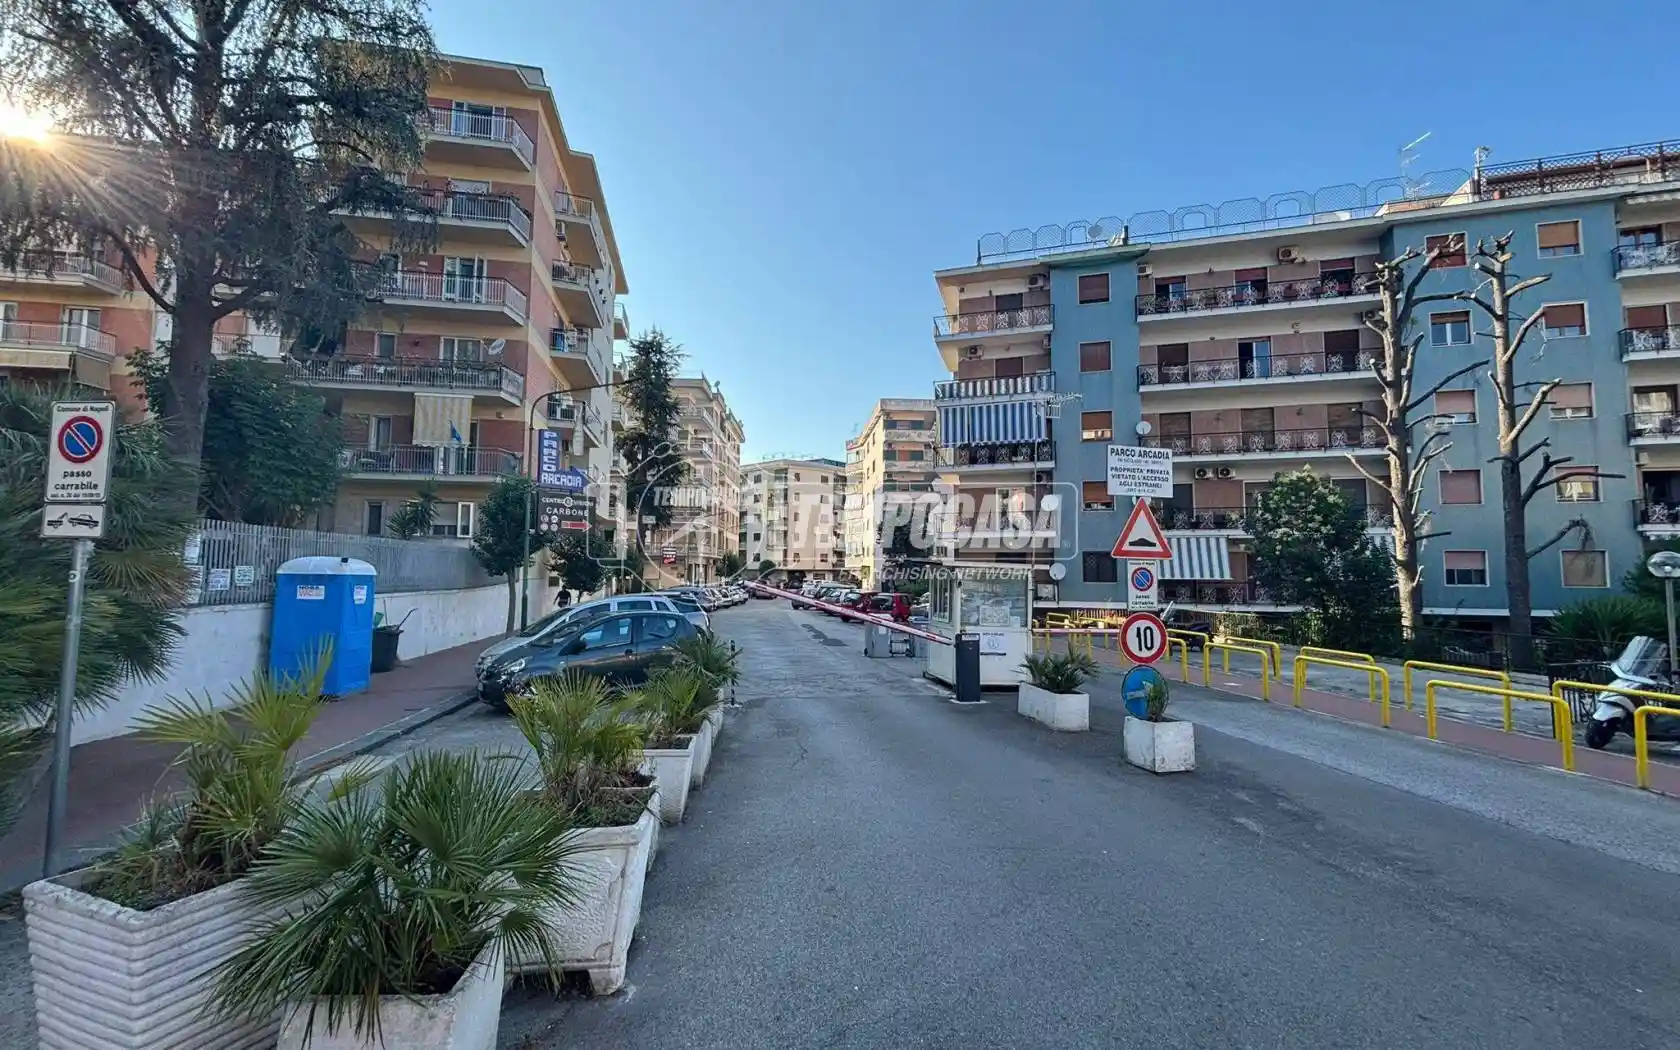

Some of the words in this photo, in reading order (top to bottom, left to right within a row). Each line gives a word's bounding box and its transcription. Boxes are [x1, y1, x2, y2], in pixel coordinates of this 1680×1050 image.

[1110, 448, 1136, 457] PARCO
[1138, 450, 1170, 460] ARCADIA
[63, 470, 92, 479] passo
[541, 472, 582, 487] ARCADIA
[54, 481, 99, 490] carrabile
[546, 506, 589, 517] CARBONE
[1135, 625, 1155, 652] 10
